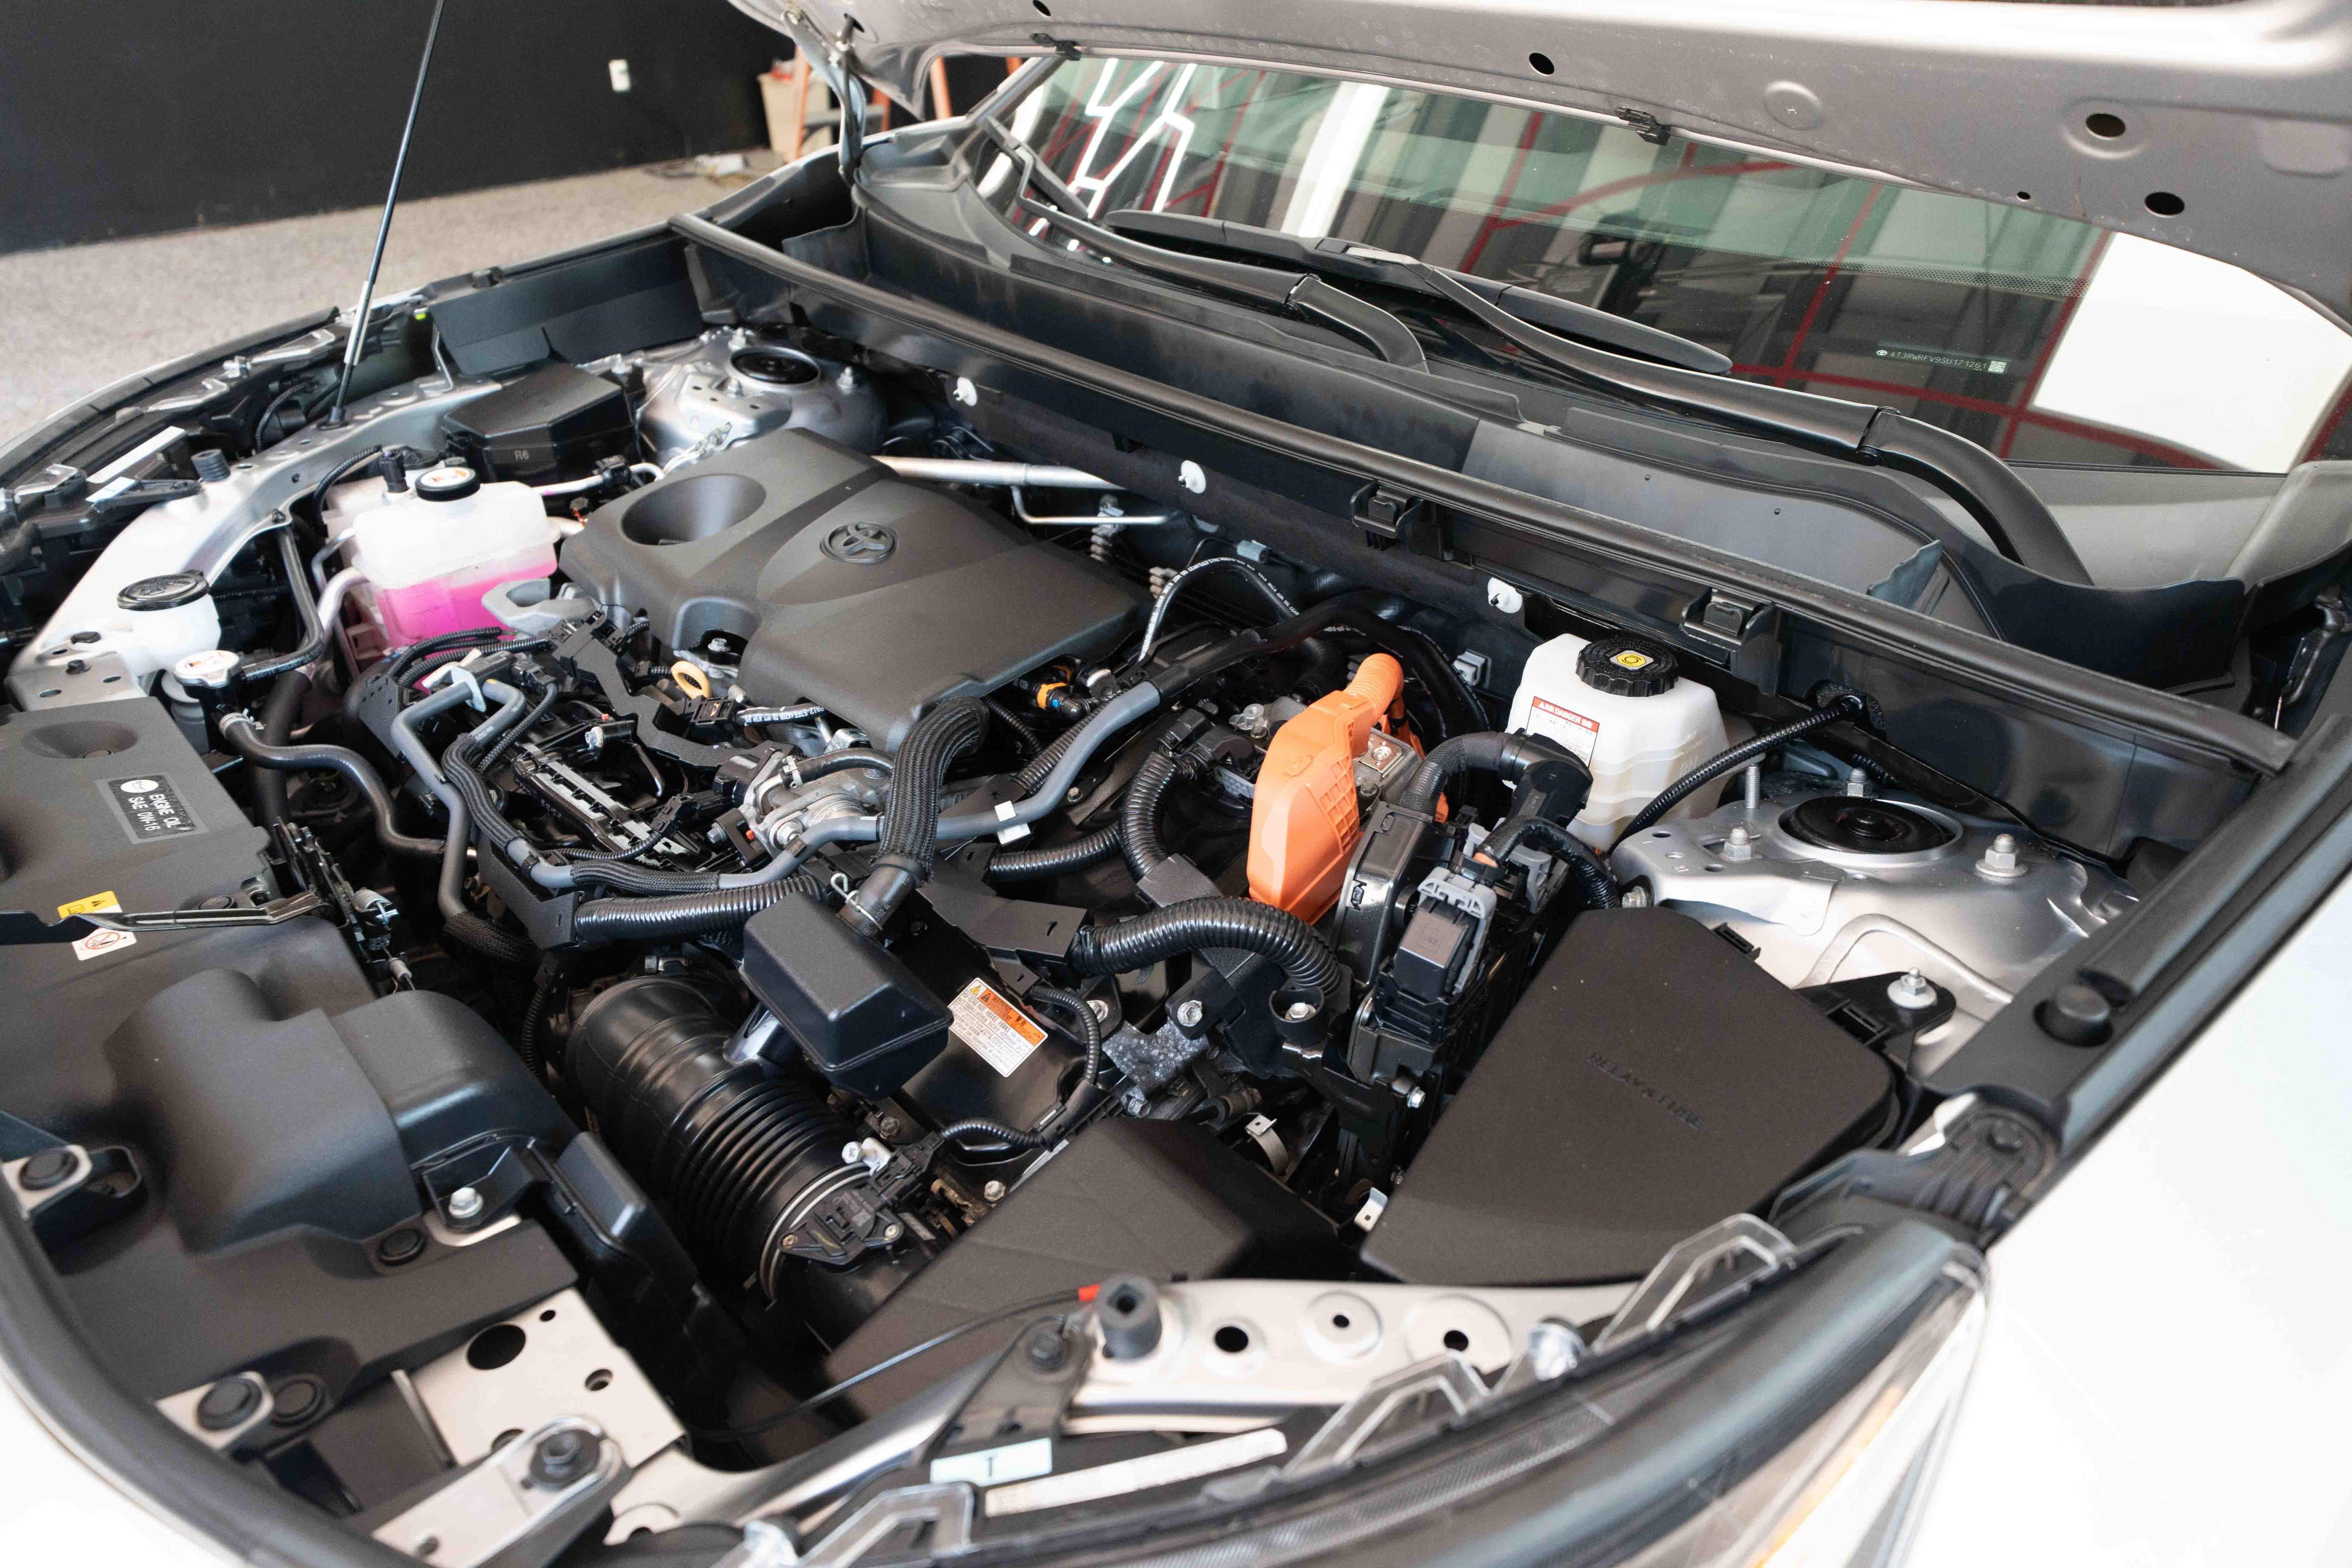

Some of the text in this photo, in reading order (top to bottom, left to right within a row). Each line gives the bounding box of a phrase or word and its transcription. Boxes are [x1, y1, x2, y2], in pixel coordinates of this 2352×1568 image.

[1890, 351, 1987, 369] 4T3RWRFV9SU171261
[1554, 707, 1581, 725] DANGER
[128, 797, 160, 831] SAE 0W-16
[149, 793, 182, 828] ENGINE OIL
[992, 996, 1012, 1013] WARNING
